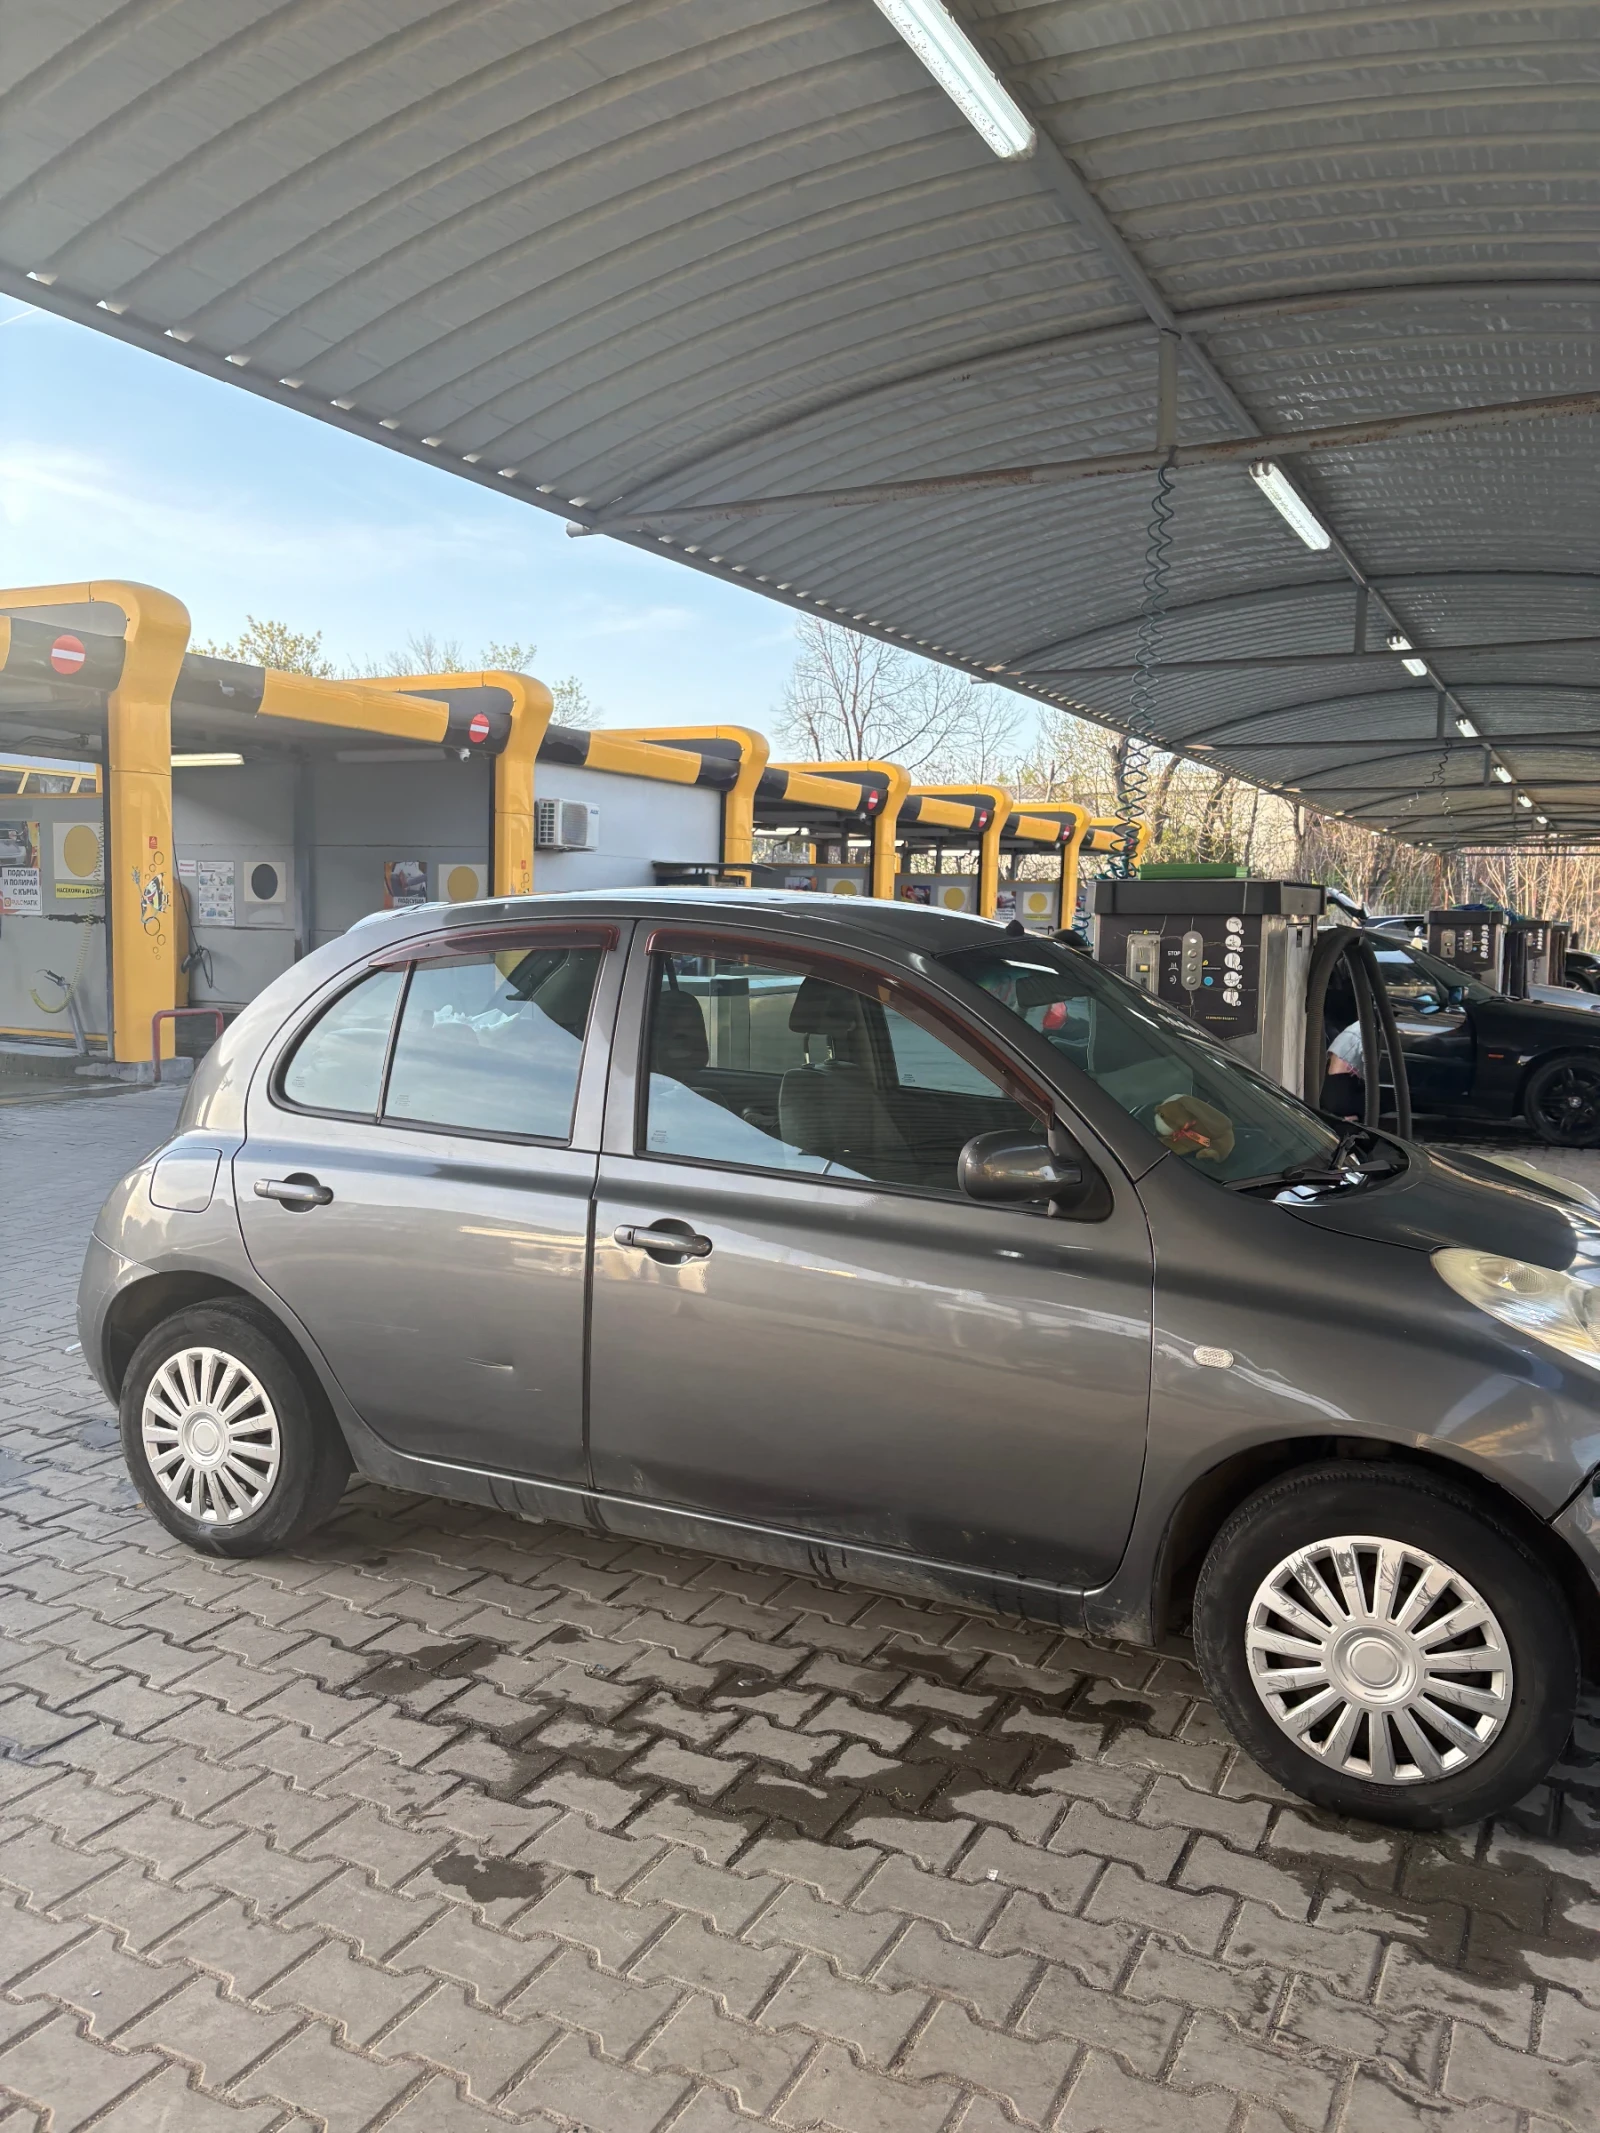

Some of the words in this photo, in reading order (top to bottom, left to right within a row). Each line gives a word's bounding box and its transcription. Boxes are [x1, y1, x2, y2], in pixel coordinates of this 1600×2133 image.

[7, 869, 38, 877] ПОДСУШИ
[4, 878, 9, 886] И
[9, 877, 38, 886] ПОЛИРАЙ
